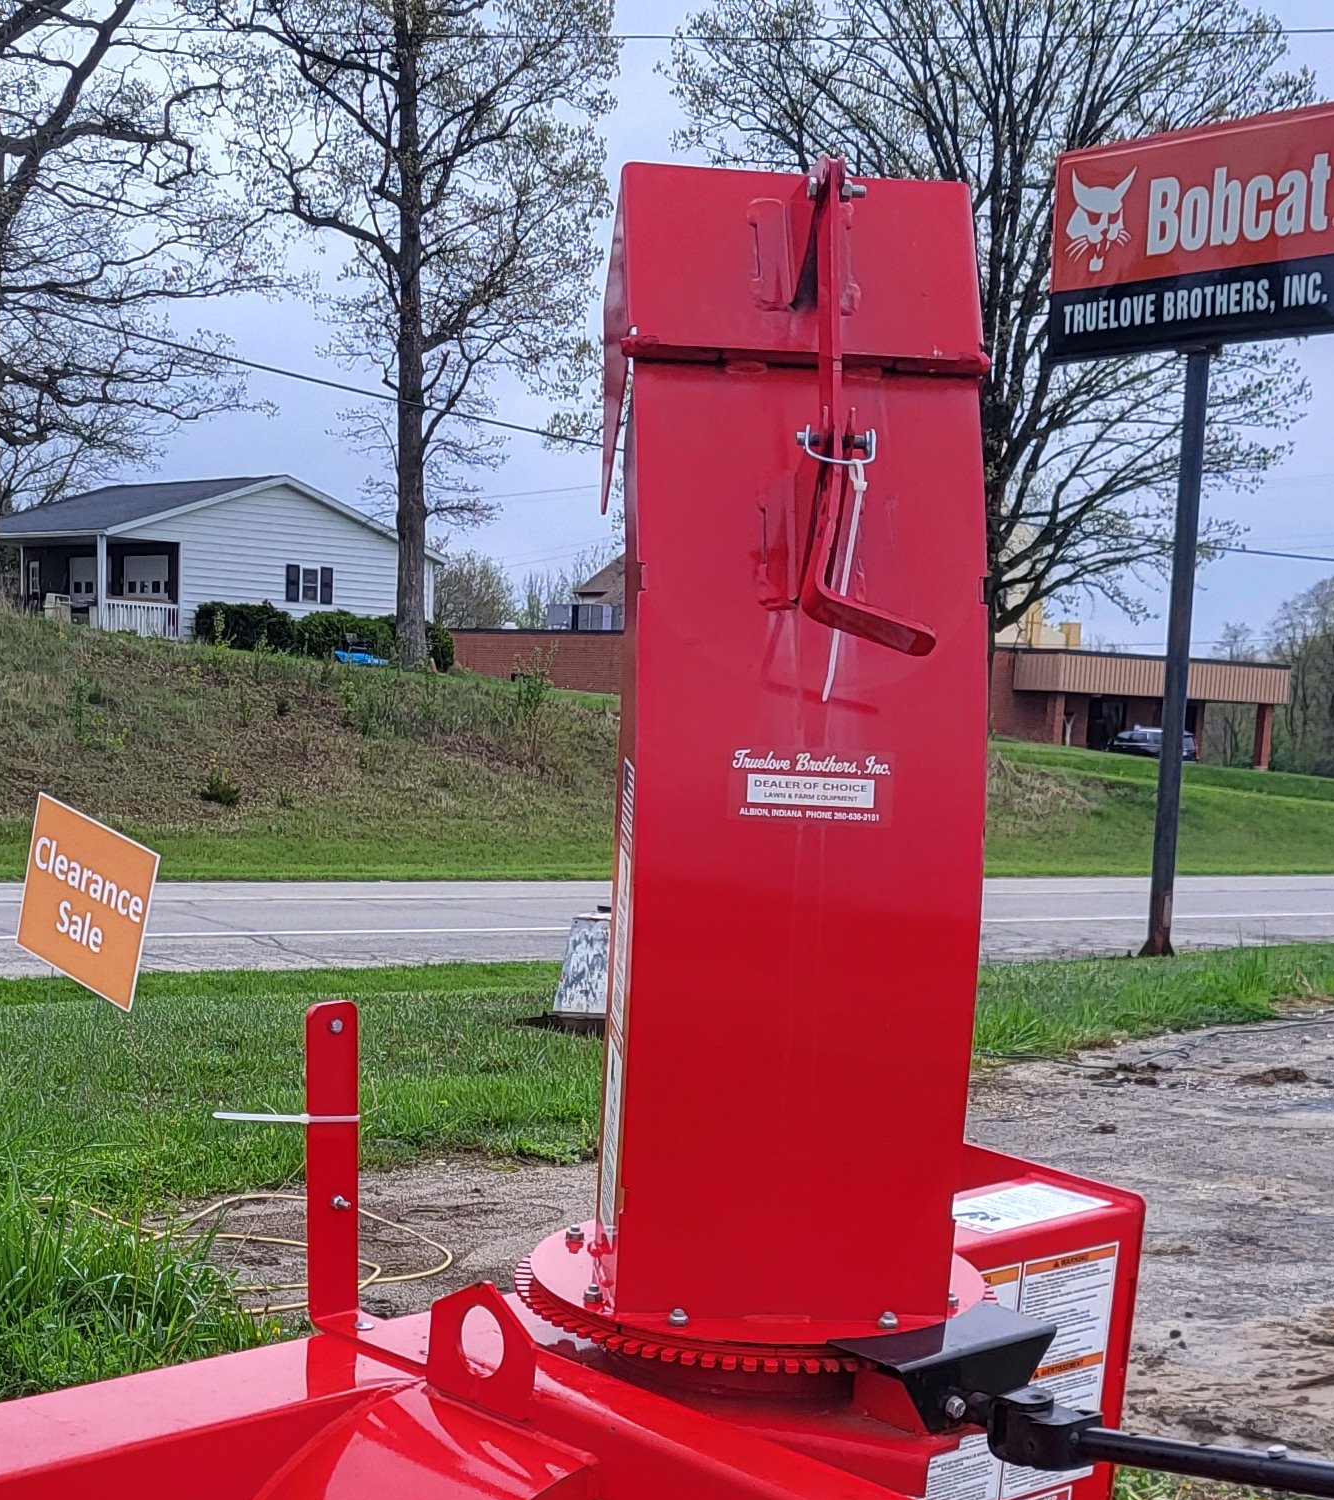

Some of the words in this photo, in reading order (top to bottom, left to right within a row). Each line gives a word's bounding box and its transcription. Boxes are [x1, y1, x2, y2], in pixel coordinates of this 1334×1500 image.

[1146, 153, 1330, 256] Bobcat
[1063, 294, 1156, 335] TRUELOVE
[1163, 279, 1277, 323] BROTHERS,
[1283, 271, 1328, 307] INC.
[732, 748, 791, 770] Truelove
[796, 753, 862, 776] Brothers,
[864, 756, 891, 776] Inc.
[754, 779, 801, 790] DEALER
[803, 781, 819, 790] OF
[823, 783, 868, 793] CHOICE
[817, 795, 858, 803] EQUIPMENT
[739, 807, 770, 817] ALBION,
[772, 808, 802, 818] INDIANA
[806, 810, 832, 819] PHONE
[34, 836, 143, 923] Clearance
[55, 901, 103, 953] Sale
